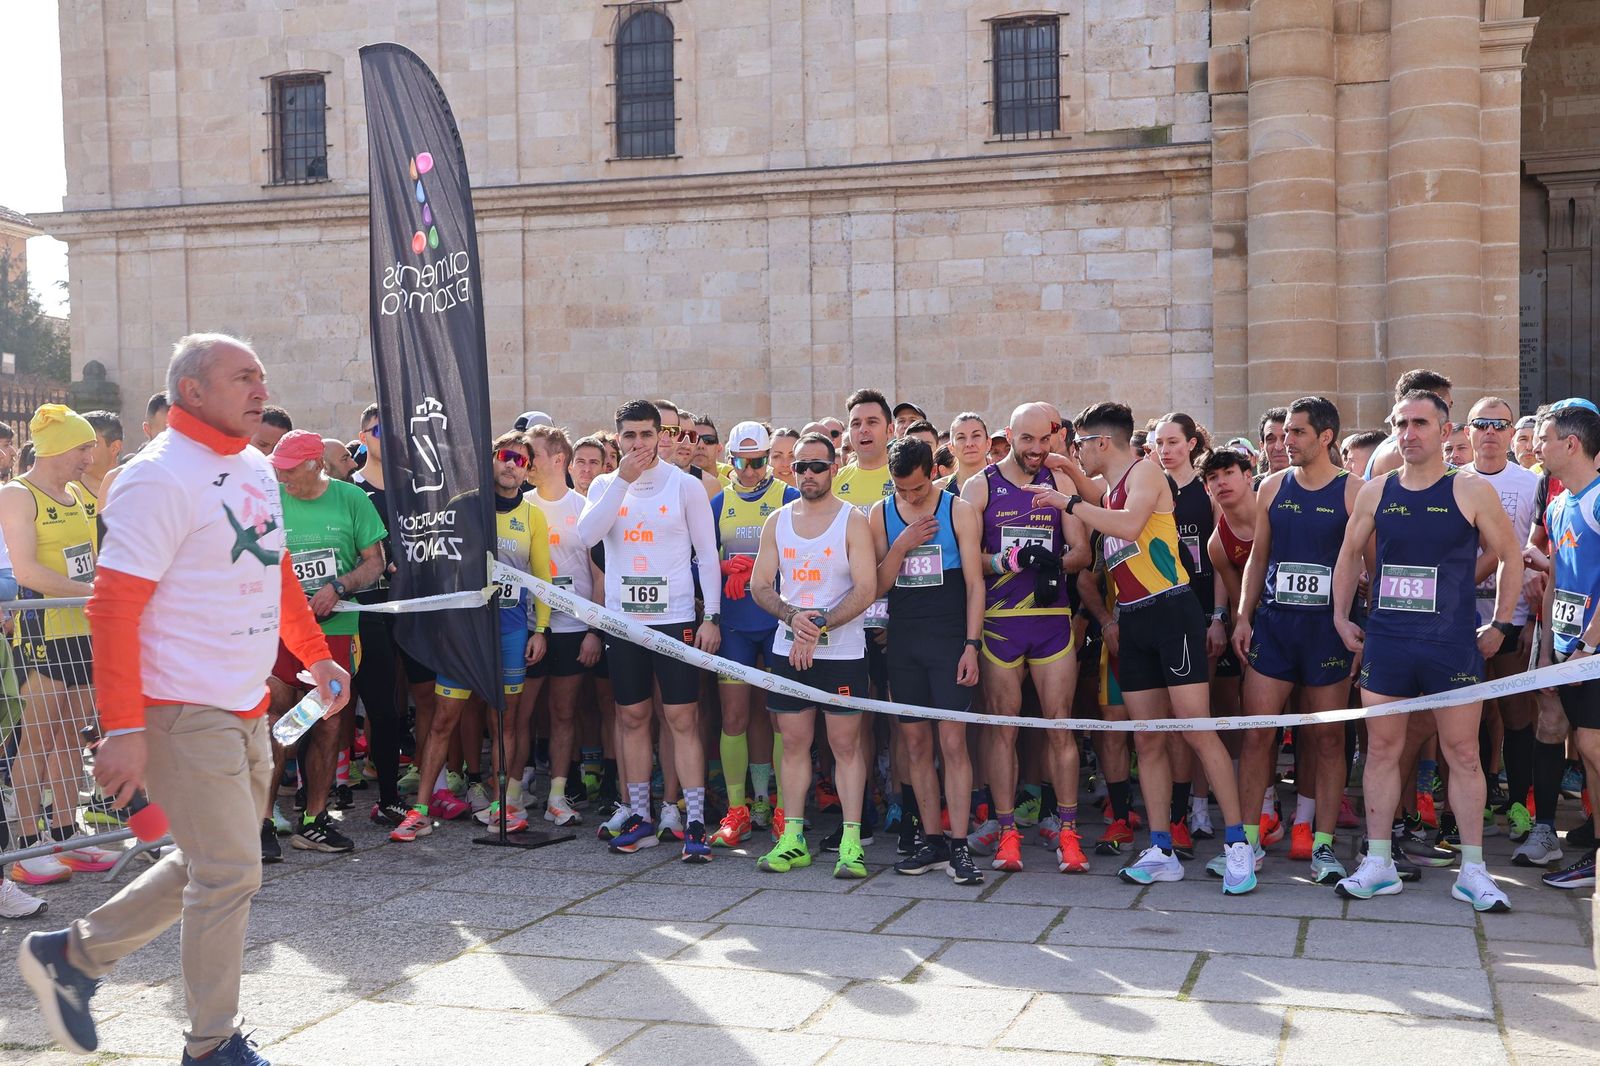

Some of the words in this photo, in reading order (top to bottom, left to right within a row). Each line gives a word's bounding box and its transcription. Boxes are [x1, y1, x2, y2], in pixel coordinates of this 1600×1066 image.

[294, 560, 326, 580] 350
[1286, 574, 1319, 593] 188
[1389, 578, 1424, 598] 763
[628, 586, 659, 602] 169
[1554, 602, 1576, 622] 213
